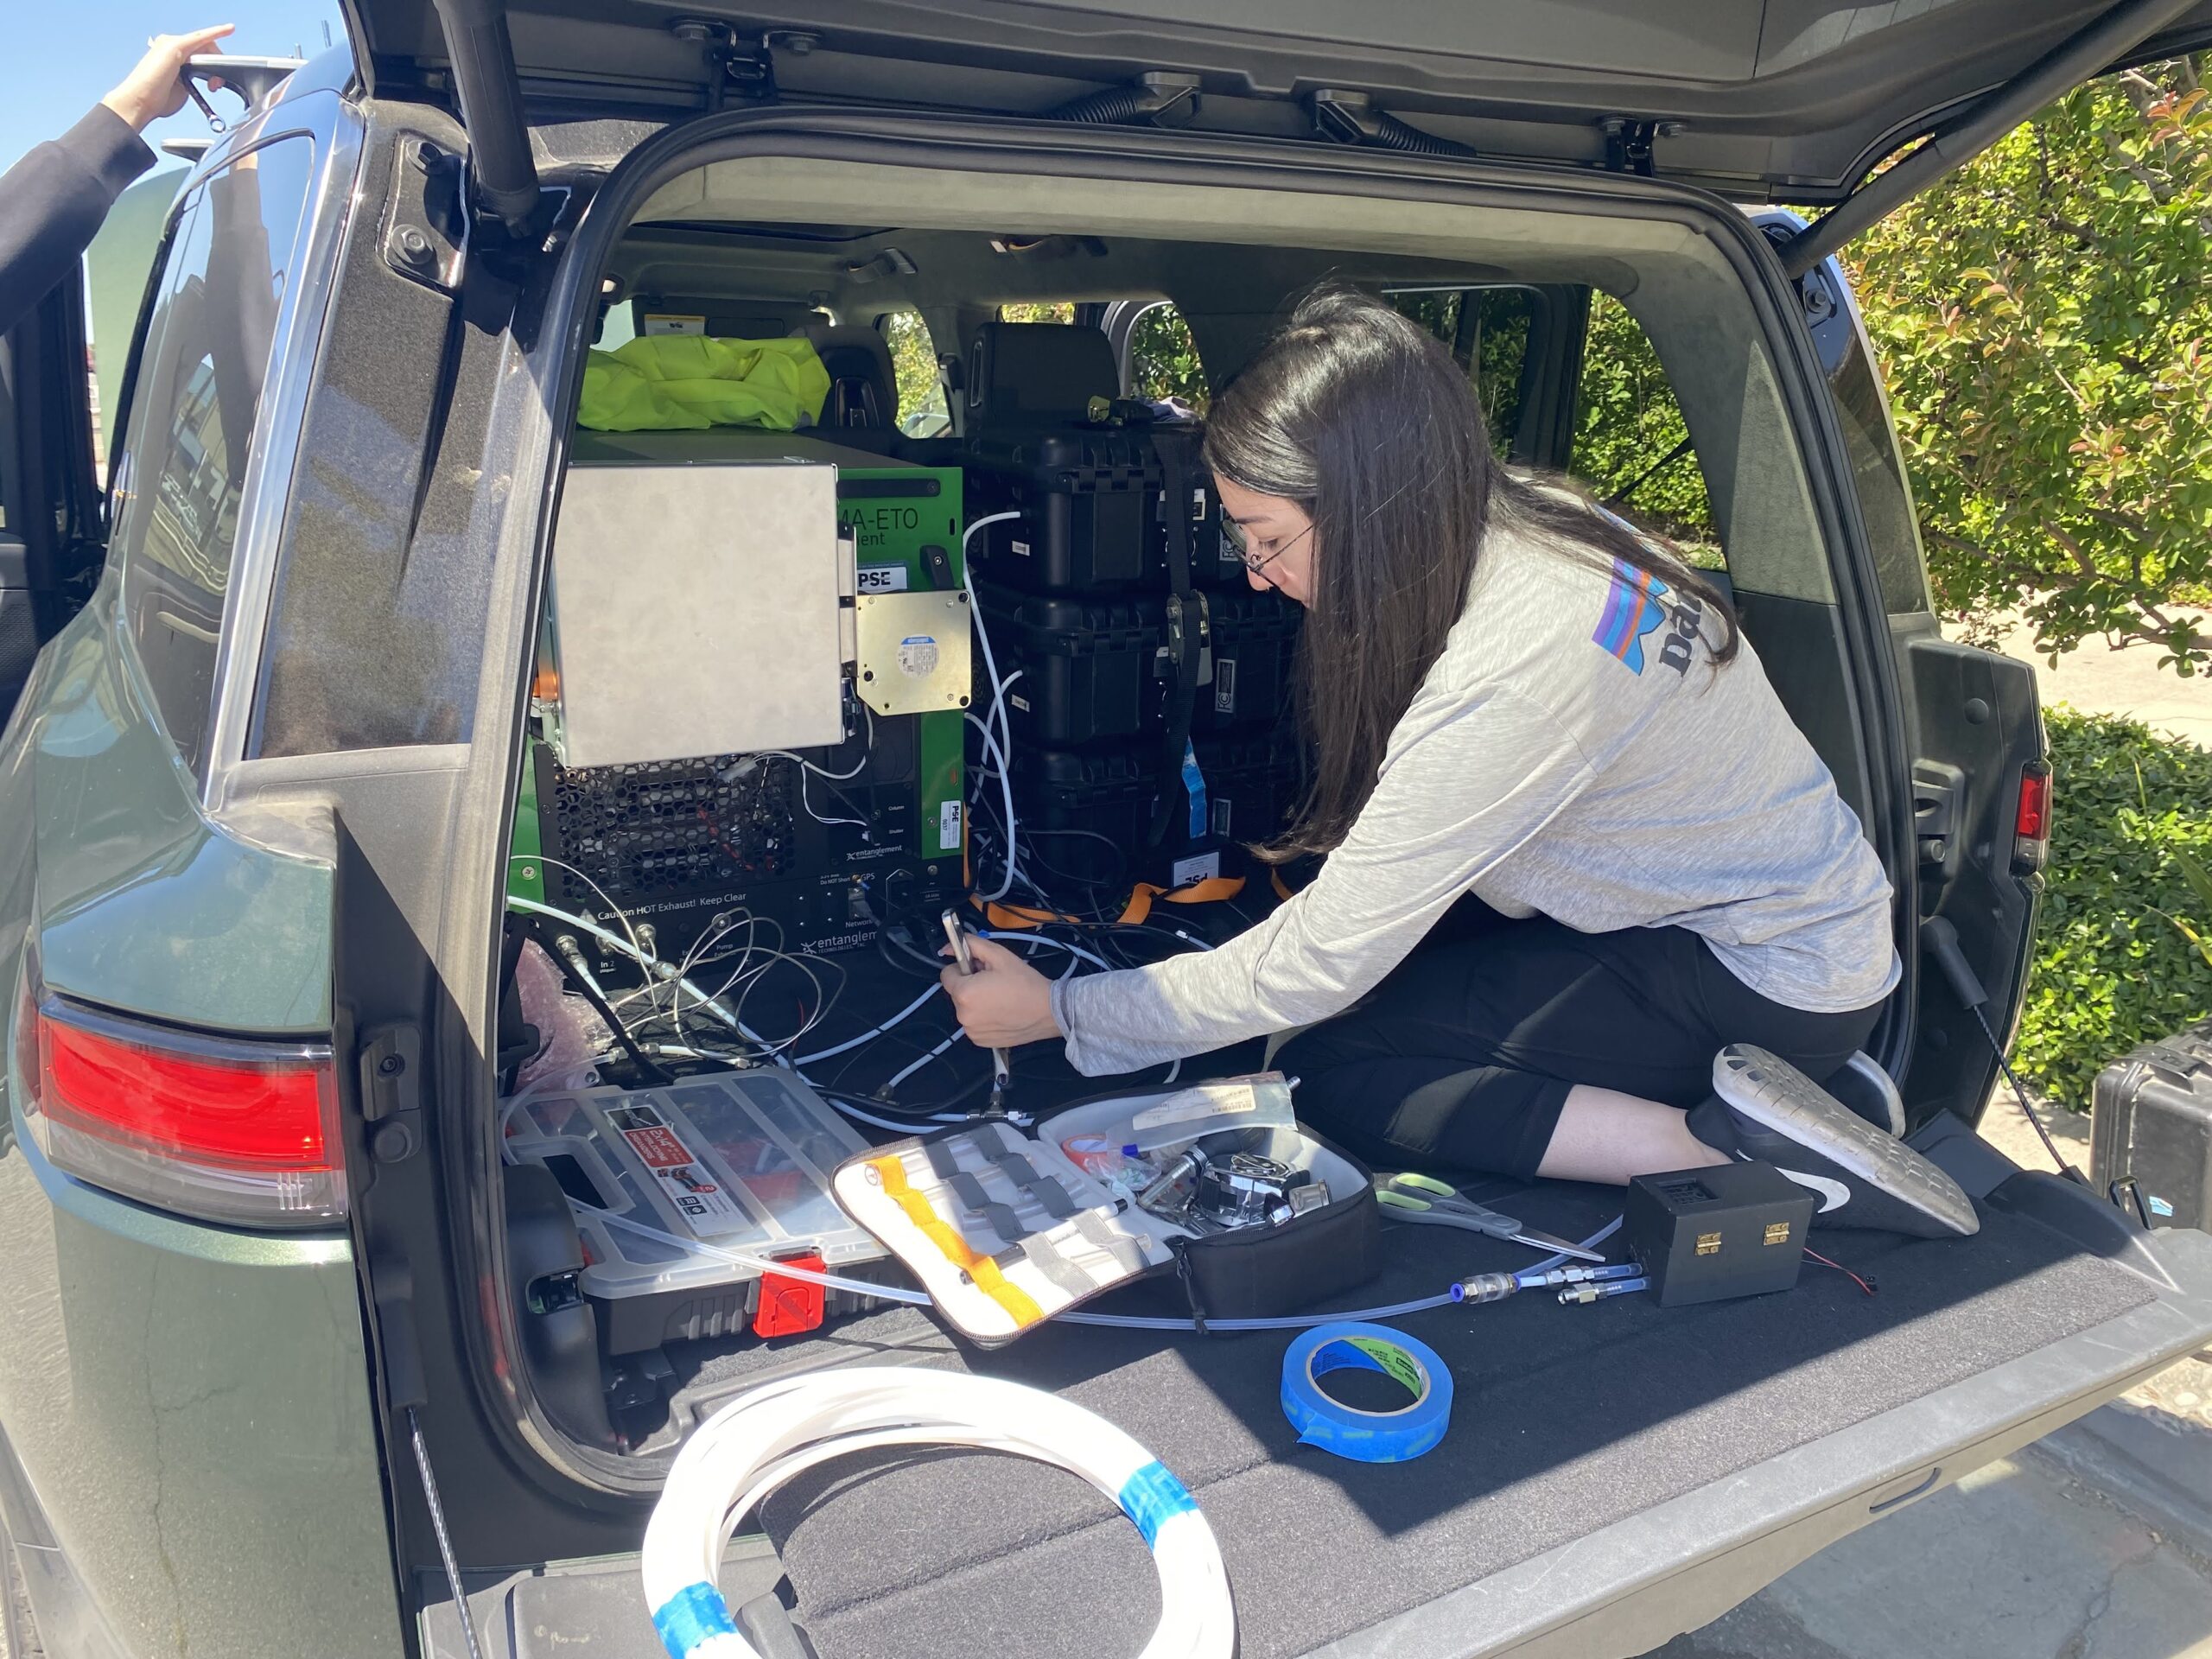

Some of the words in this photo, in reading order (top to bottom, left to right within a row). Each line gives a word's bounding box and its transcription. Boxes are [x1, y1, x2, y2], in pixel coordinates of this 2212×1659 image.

[858, 571, 891, 588] PSE
[855, 844, 903, 857] entanglement
[861, 872, 875, 881] GPS
[637, 904, 657, 915] HOT
[658, 899, 696, 912] Exhaust!
[700, 897, 722, 906] Keep
[724, 893, 747, 903] Clear
